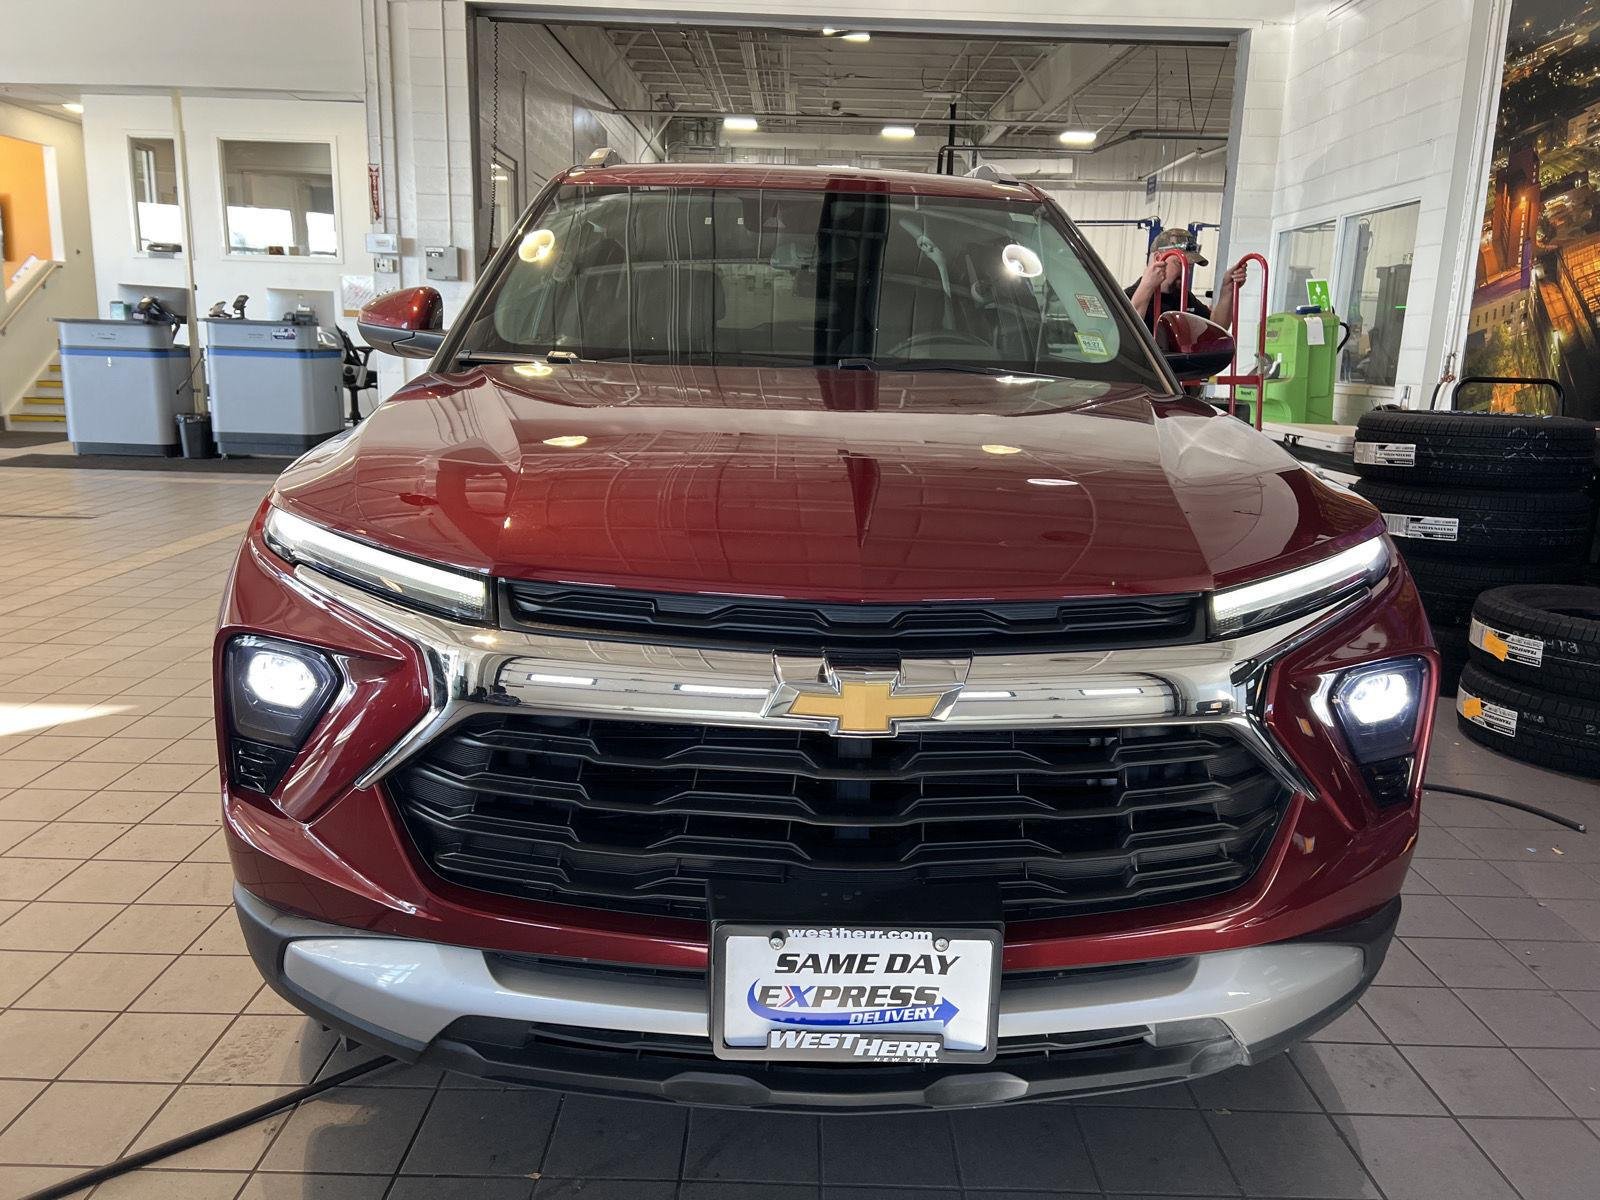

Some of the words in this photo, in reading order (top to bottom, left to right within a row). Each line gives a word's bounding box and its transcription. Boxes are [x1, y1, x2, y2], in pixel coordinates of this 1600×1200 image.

[786, 928, 933, 940] westherr.com
[774, 953, 879, 974] SAME
[884, 953, 961, 975] DAY
[758, 985, 940, 1009] EXPRESS
[848, 1007, 939, 1025] DELIVERY
